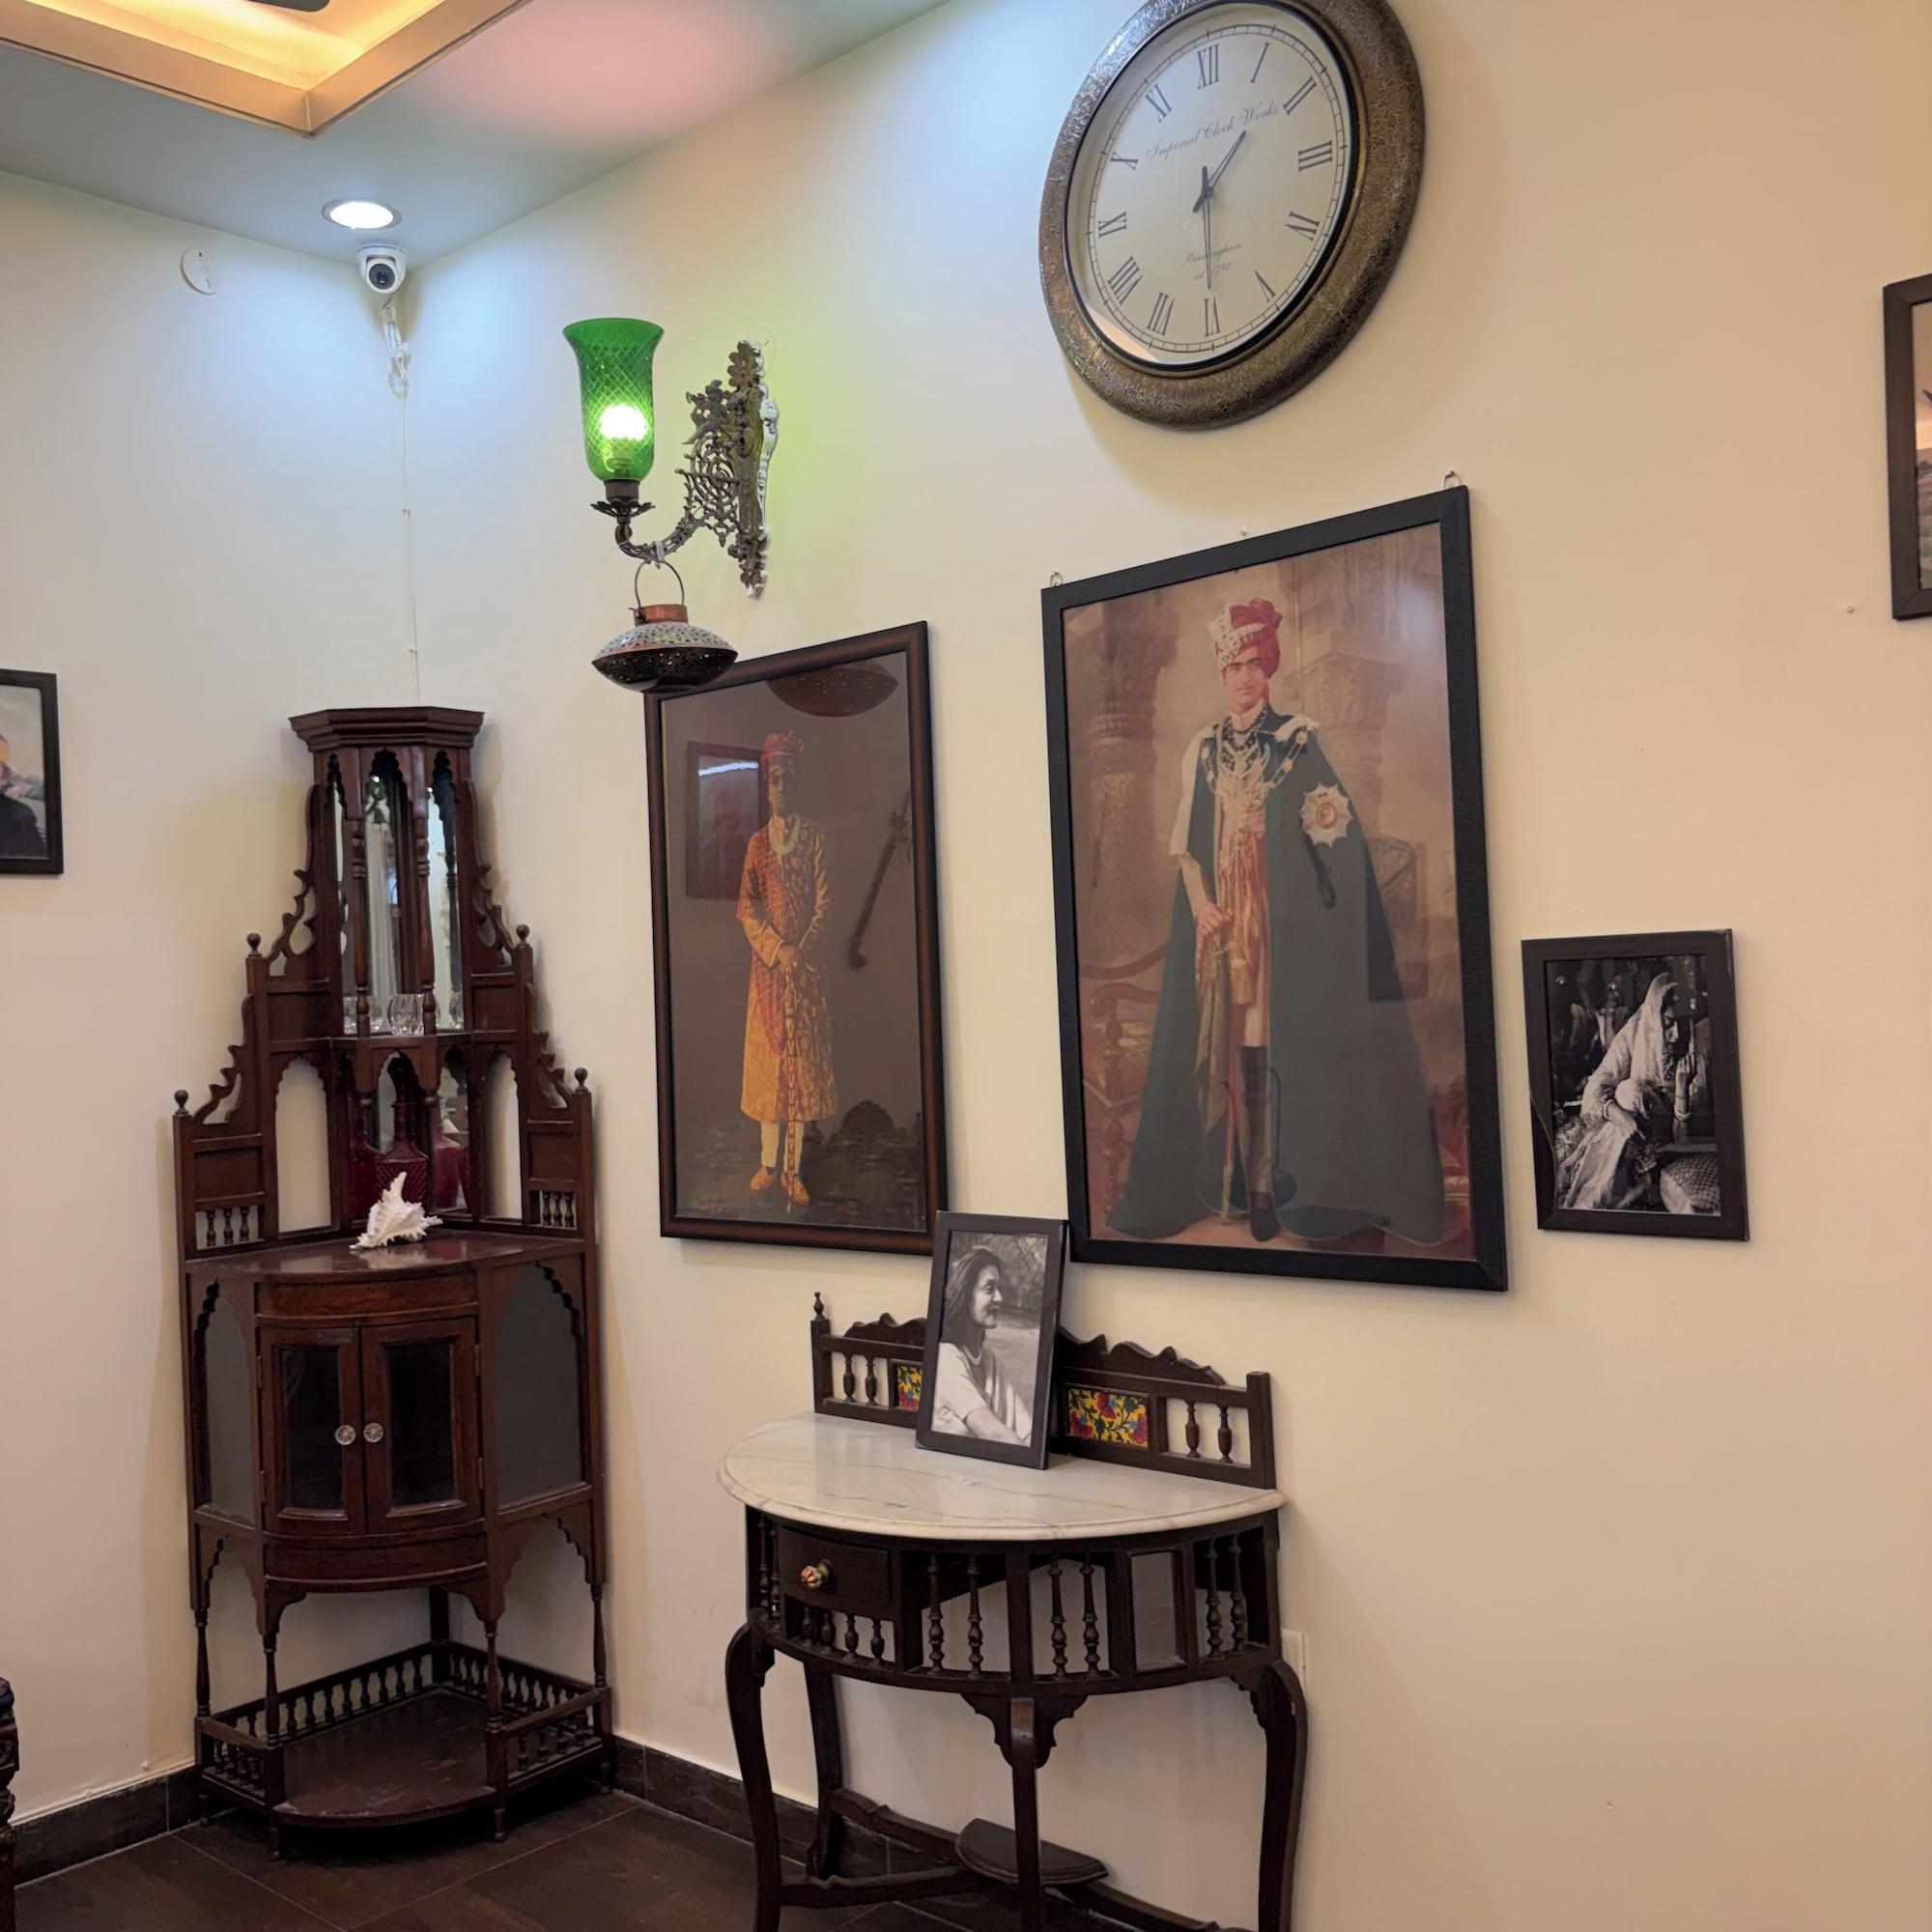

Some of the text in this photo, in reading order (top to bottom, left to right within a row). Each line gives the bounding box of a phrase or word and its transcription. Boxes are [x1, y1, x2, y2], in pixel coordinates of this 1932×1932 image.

[1197, 43, 1220, 90] XII
[1250, 42, 1270, 84] I
[1145, 83, 1173, 123] XI
[1283, 75, 1318, 116] II
[1145, 99, 1279, 161] Imperial Clock Works
[1110, 151, 1139, 170] X
[1297, 139, 1333, 172] III
[1098, 211, 1127, 239] IX
[1285, 211, 1321, 242] IV
[1107, 255, 1144, 305] VIII
[1254, 270, 1276, 303] V
[1146, 292, 1176, 336] VII
[1204, 296, 1221, 337] VI
